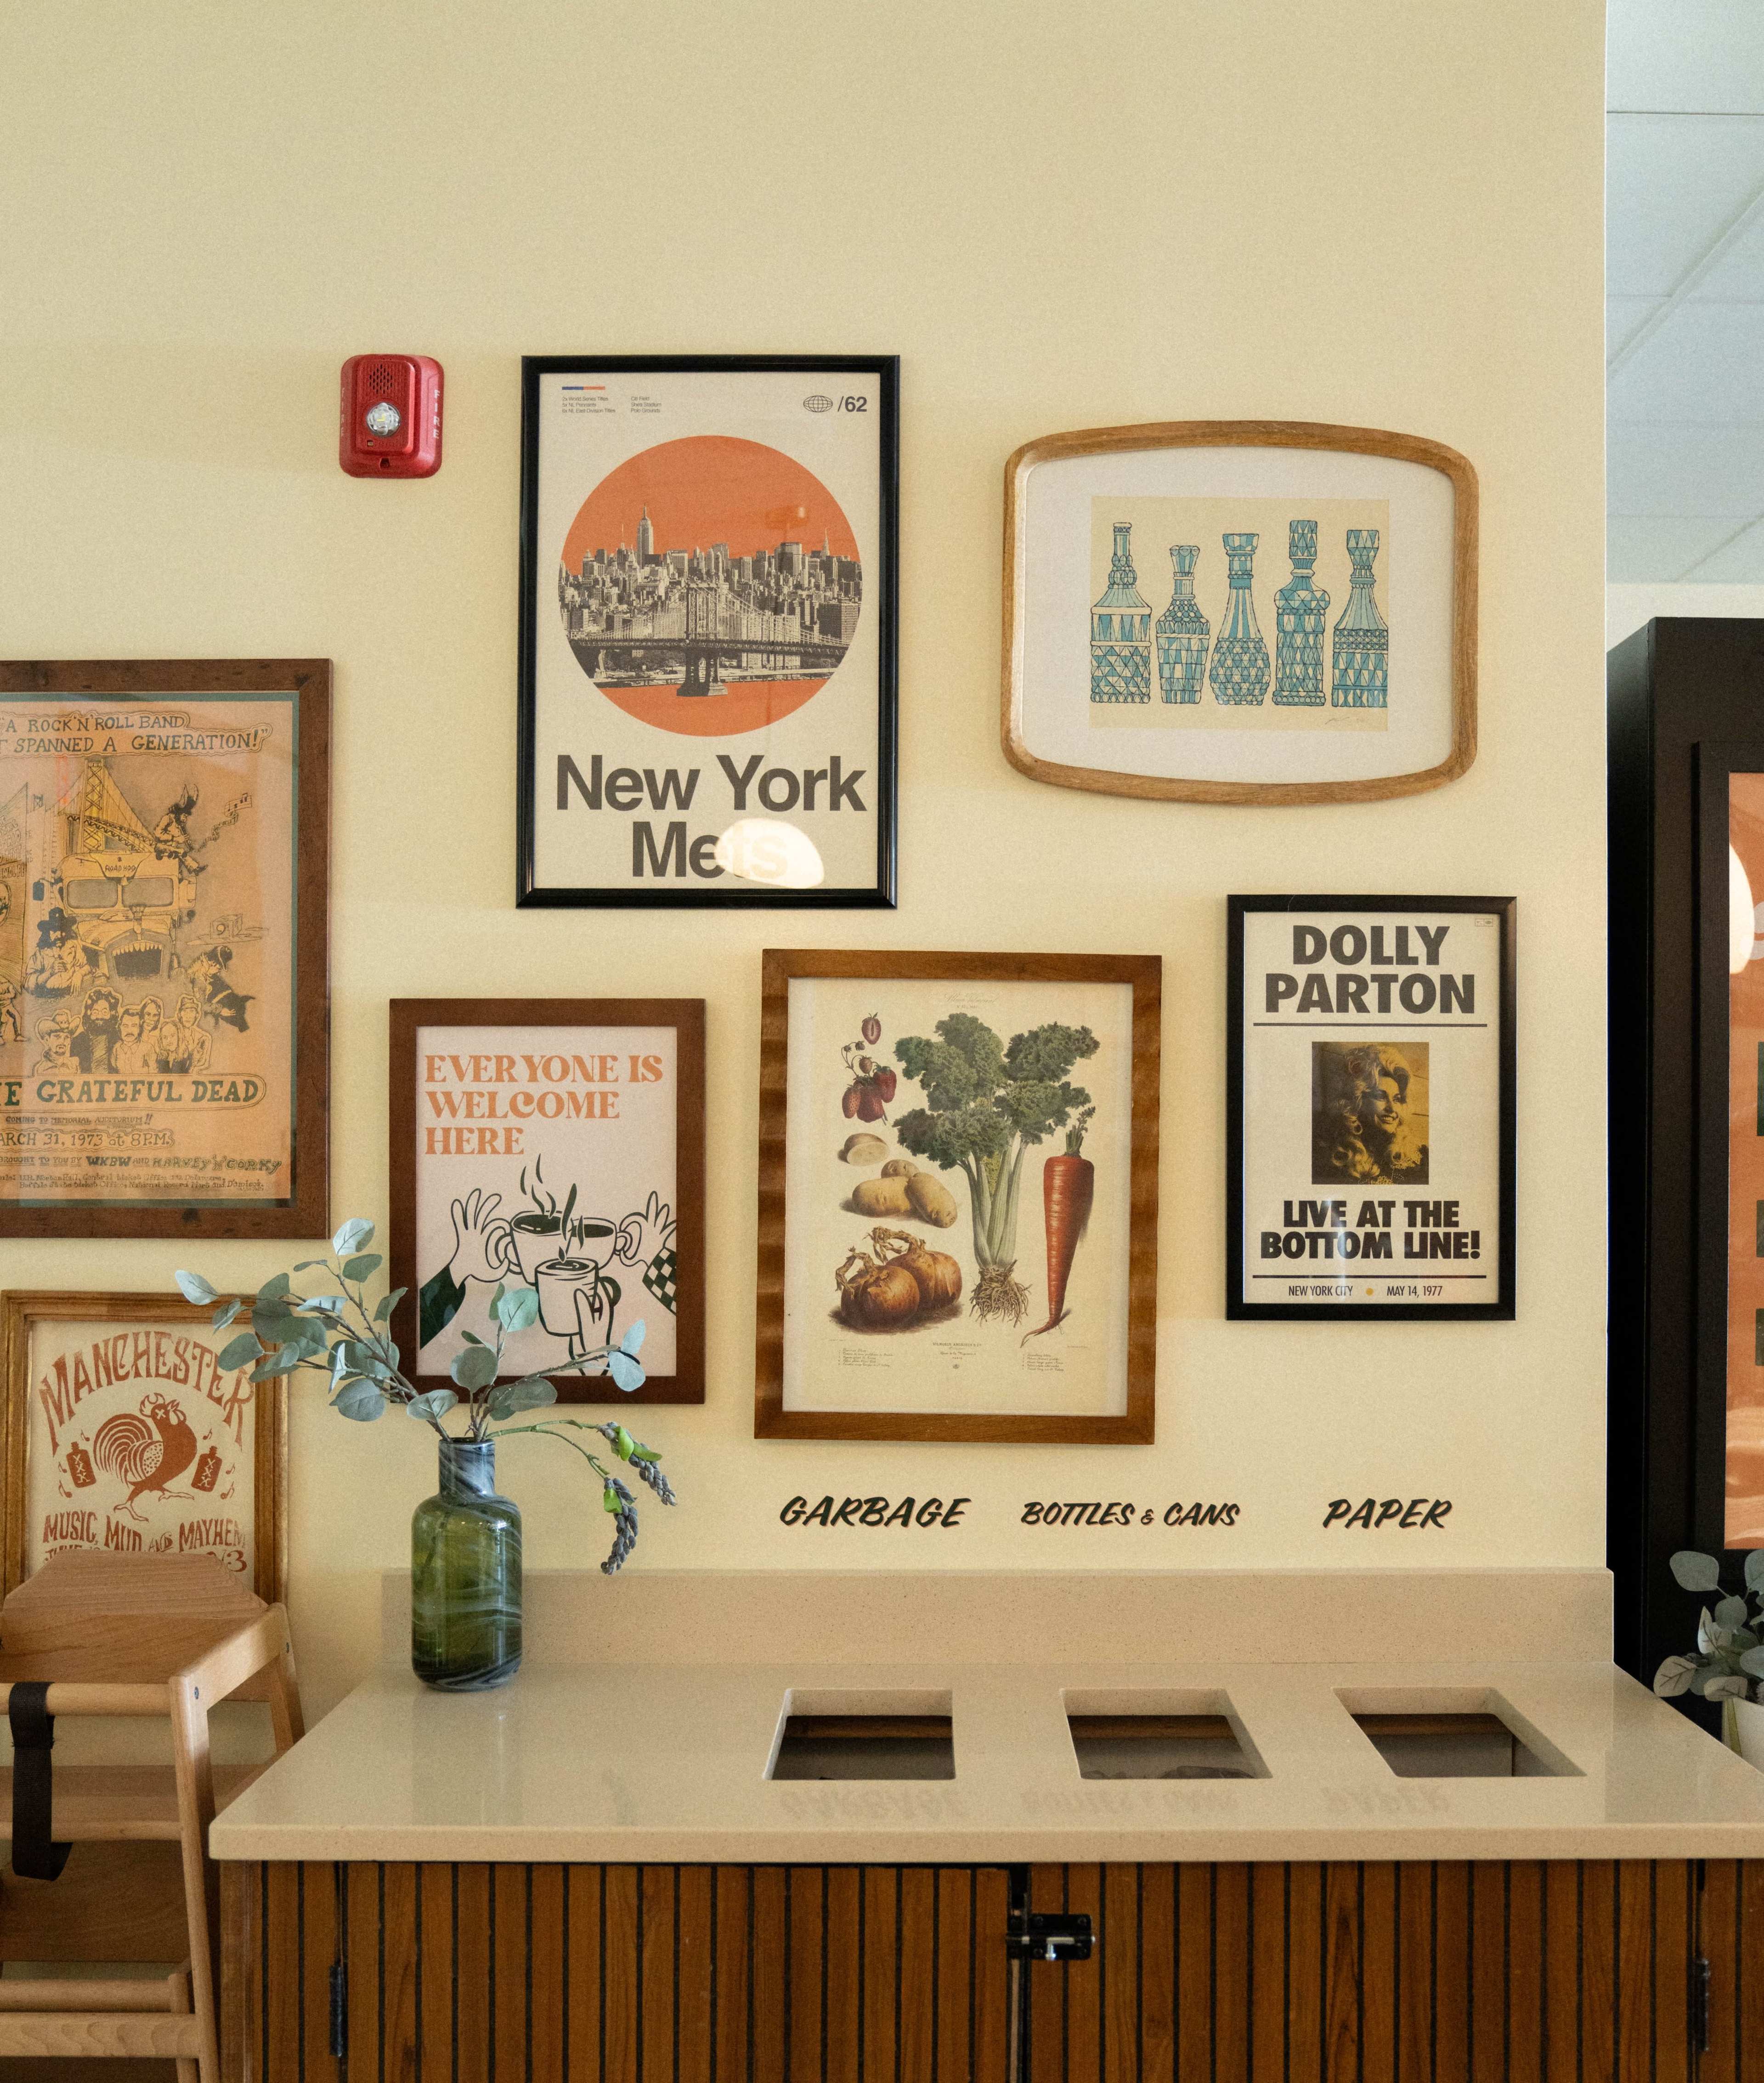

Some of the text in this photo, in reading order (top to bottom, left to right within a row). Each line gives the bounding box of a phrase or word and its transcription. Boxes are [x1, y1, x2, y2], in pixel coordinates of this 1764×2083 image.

[837, 396, 867, 412] /62
[139, 716, 185, 729] BAND
[14, 737, 93, 753] SPANNED
[103, 736, 117, 752] A
[557, 754, 867, 812] New York
[1293, 925, 1450, 966] DOLLY
[1266, 973, 1475, 1014] PARTON
[425, 1055, 663, 1083] EVERYONE IS
[37, 1080, 182, 1103] GRATEFUL
[191, 1080, 259, 1103] DEAD
[425, 1091, 620, 1119] WELCOME
[71, 1133, 102, 1147] 1973
[109, 1133, 124, 1146] at
[425, 1126, 524, 1155] HERE
[86, 1156, 132, 1166] WKBW
[1284, 1200, 1459, 1228] LIVE AT THE
[1261, 1230, 1480, 1259] BOTTOM LINE!
[1289, 1286, 1442, 1298] NEW YORK CITY MAY 14, 1977
[39, 1331, 255, 1458] MANCHESTER
[780, 1495, 972, 1528] GARBAGE
[1021, 1501, 1241, 1527] BOTTLES & CANS
[1323, 1498, 1452, 1530] PAPER
[42, 1510, 98, 1545] MUSIC,
[148, 1531, 174, 1553] AND
